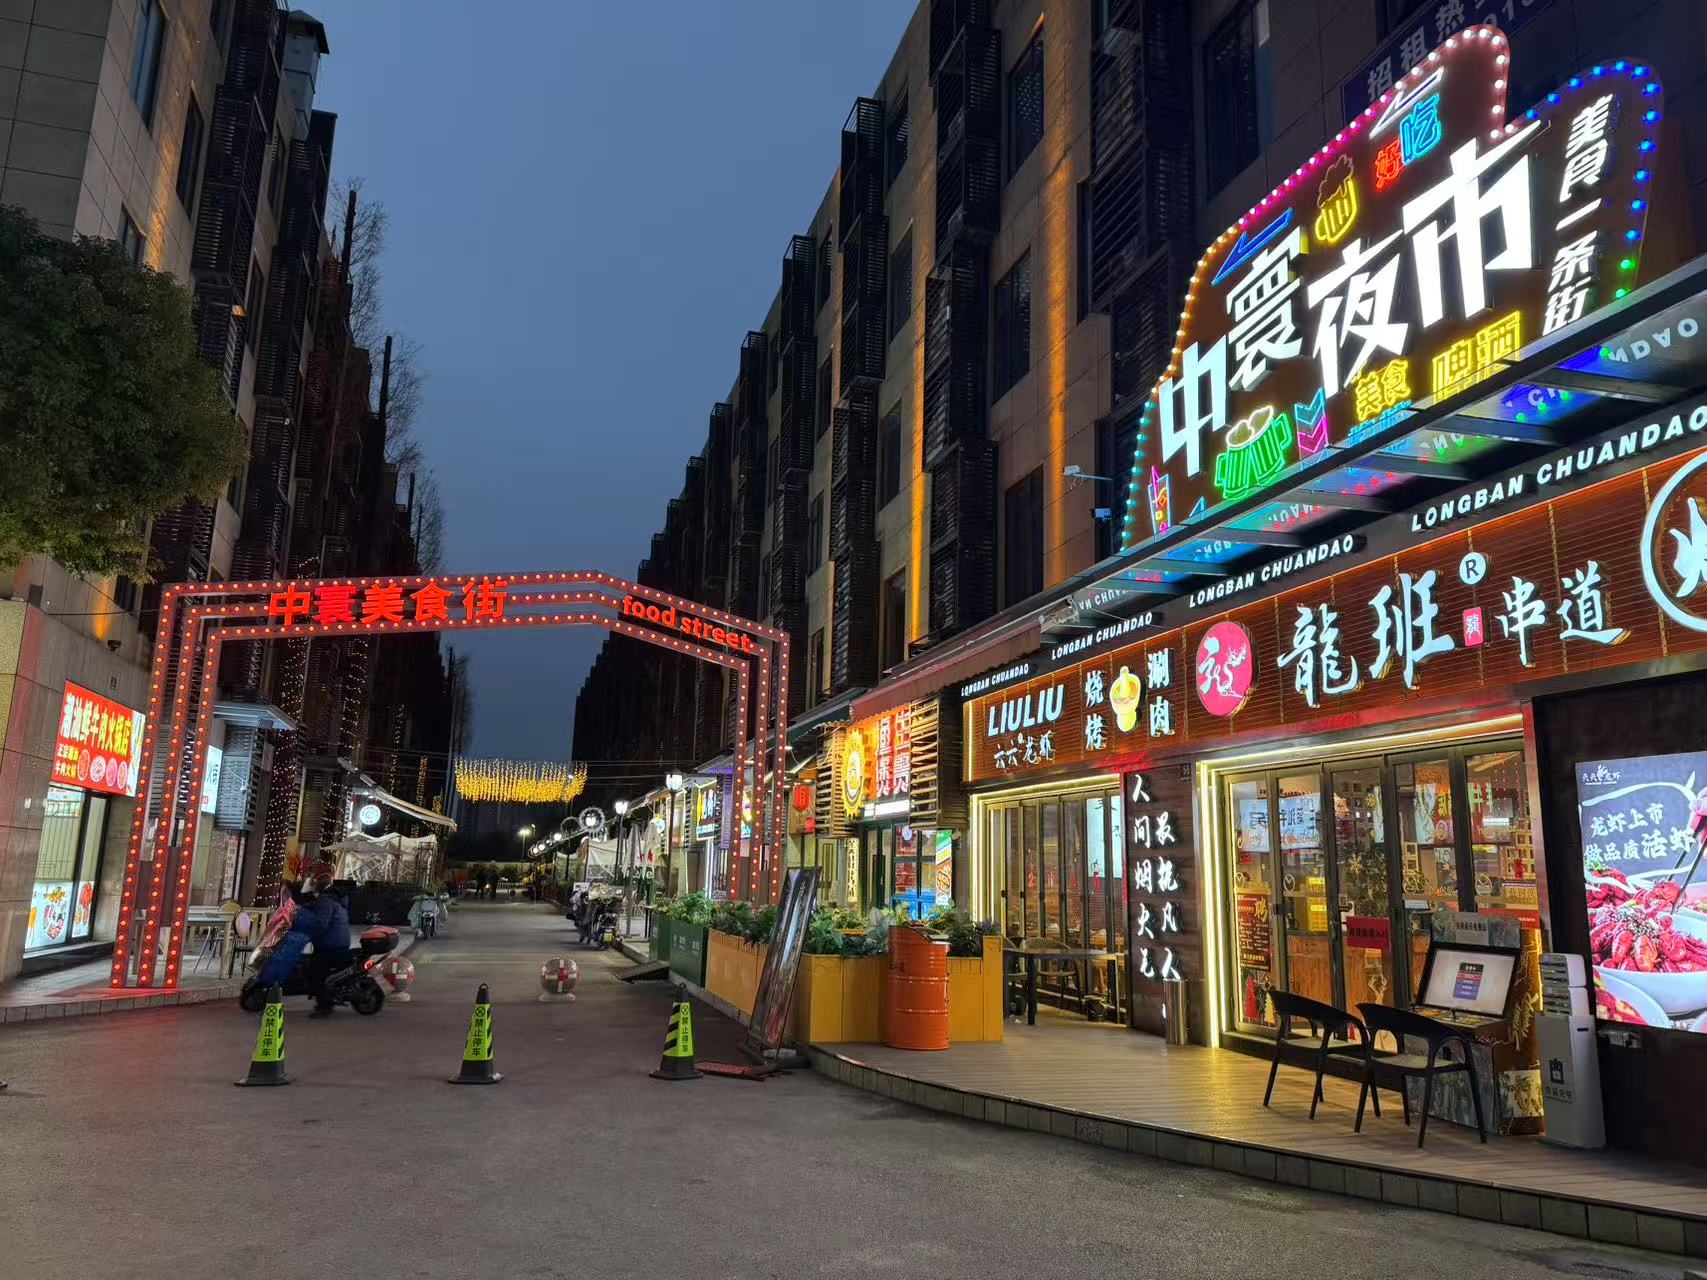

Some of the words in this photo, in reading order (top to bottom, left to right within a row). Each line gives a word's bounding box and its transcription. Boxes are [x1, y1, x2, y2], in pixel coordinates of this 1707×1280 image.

[1375, 94, 1442, 191] 好吃
[1542, 93, 1613, 336] 美食一条街
[1159, 120, 1541, 478] 中寰夜市
[1355, 359, 1411, 421] 美食
[1411, 474, 1525, 532] LONGBAN
[1536, 404, 1707, 486] CHUANDAO
[1188, 570, 1255, 608] LONGBAN
[1260, 534, 1354, 583] CHUANDAO
[622, 595, 677, 628] food
[680, 617, 752, 653] street
[1051, 635, 1093, 661] LONGBAN
[1096, 611, 1153, 643] CHUANDAO
[961, 677, 990, 697] LONGBAN
[991, 662, 1029, 686] CHUANDAO
[1147, 648, 1171, 737] 涮肉
[988, 684, 1065, 737] LIULIU
[1085, 670, 1105, 751] 烧烤
[1584, 826, 1697, 863] 做品质活虾
[1590, 802, 1664, 838] 龙虾上市
[1132, 773, 1155, 978] 人间烟火气
[261, 1017, 274, 1057] 禁止停车
[472, 1017, 484, 1057] 禁止停车
[681, 1016, 689, 1054] 禁止停车
